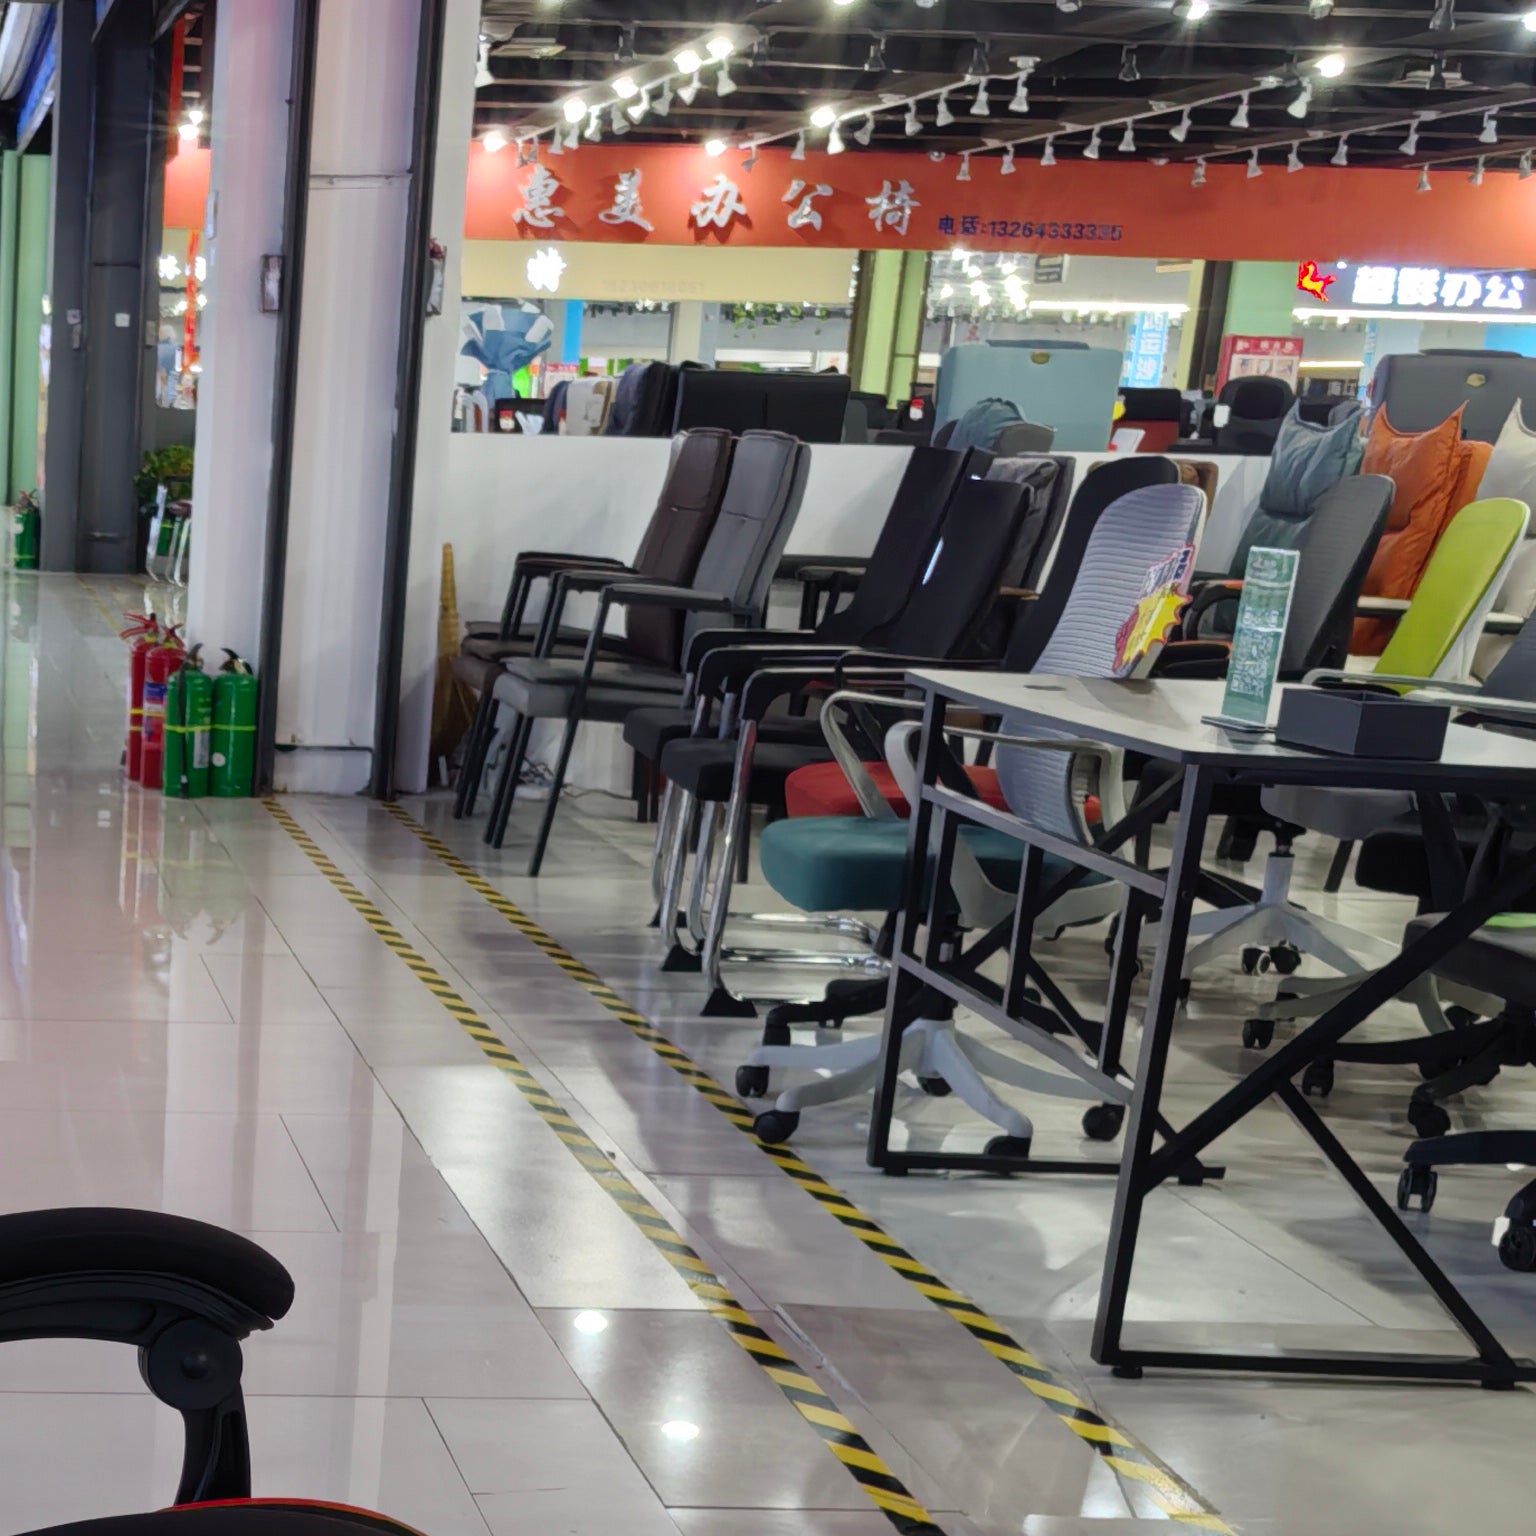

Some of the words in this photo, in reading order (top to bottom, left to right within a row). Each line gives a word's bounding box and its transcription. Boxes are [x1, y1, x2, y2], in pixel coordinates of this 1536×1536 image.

[511, 163, 922, 236] 惠美办公椅
